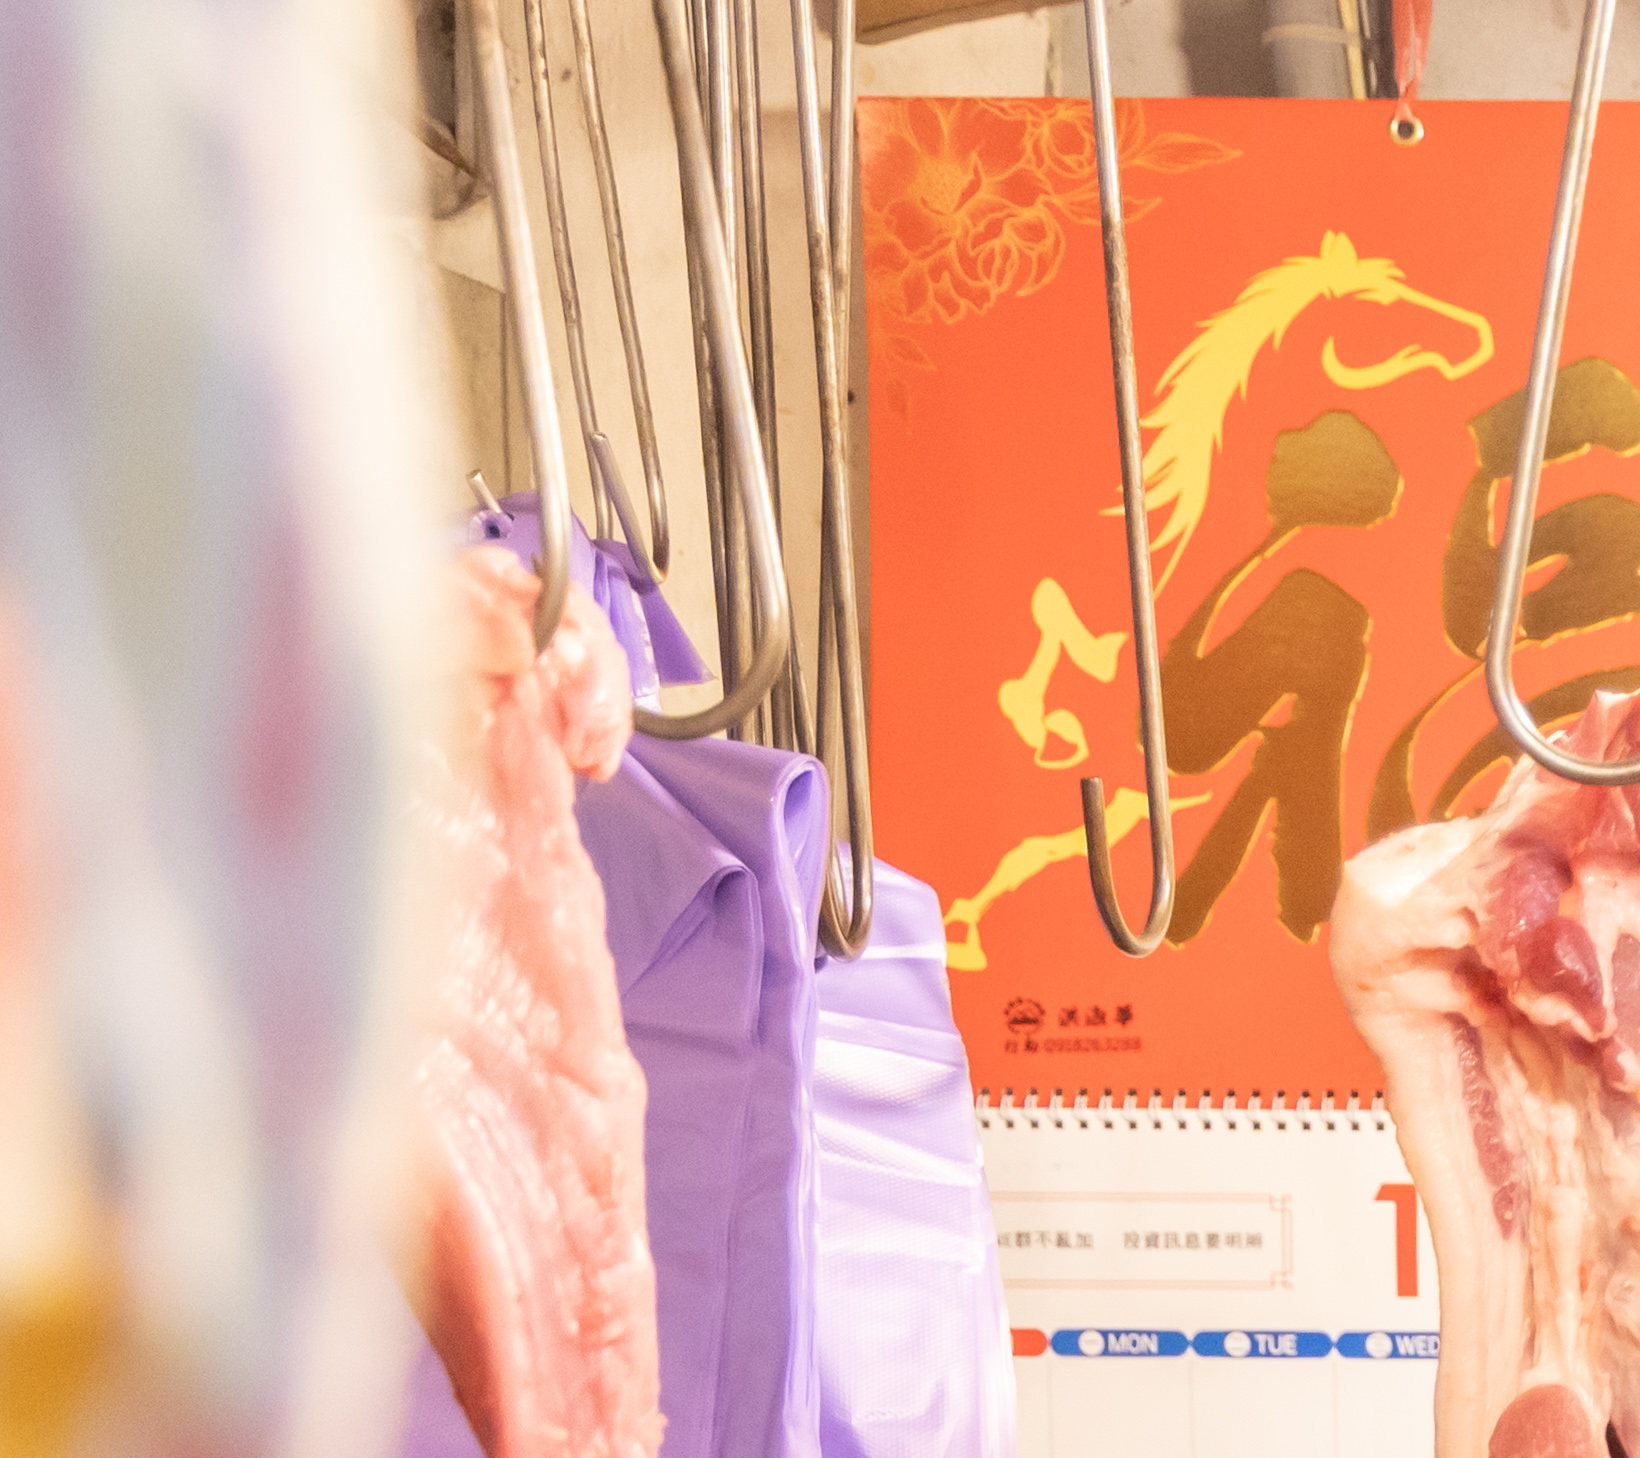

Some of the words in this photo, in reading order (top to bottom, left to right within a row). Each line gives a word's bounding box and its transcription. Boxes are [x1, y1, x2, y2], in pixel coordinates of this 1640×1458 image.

[1375, 1184, 1419, 1297] 1
[1108, 1333, 1159, 1355] MON
[1255, 1333, 1298, 1357] TUE
